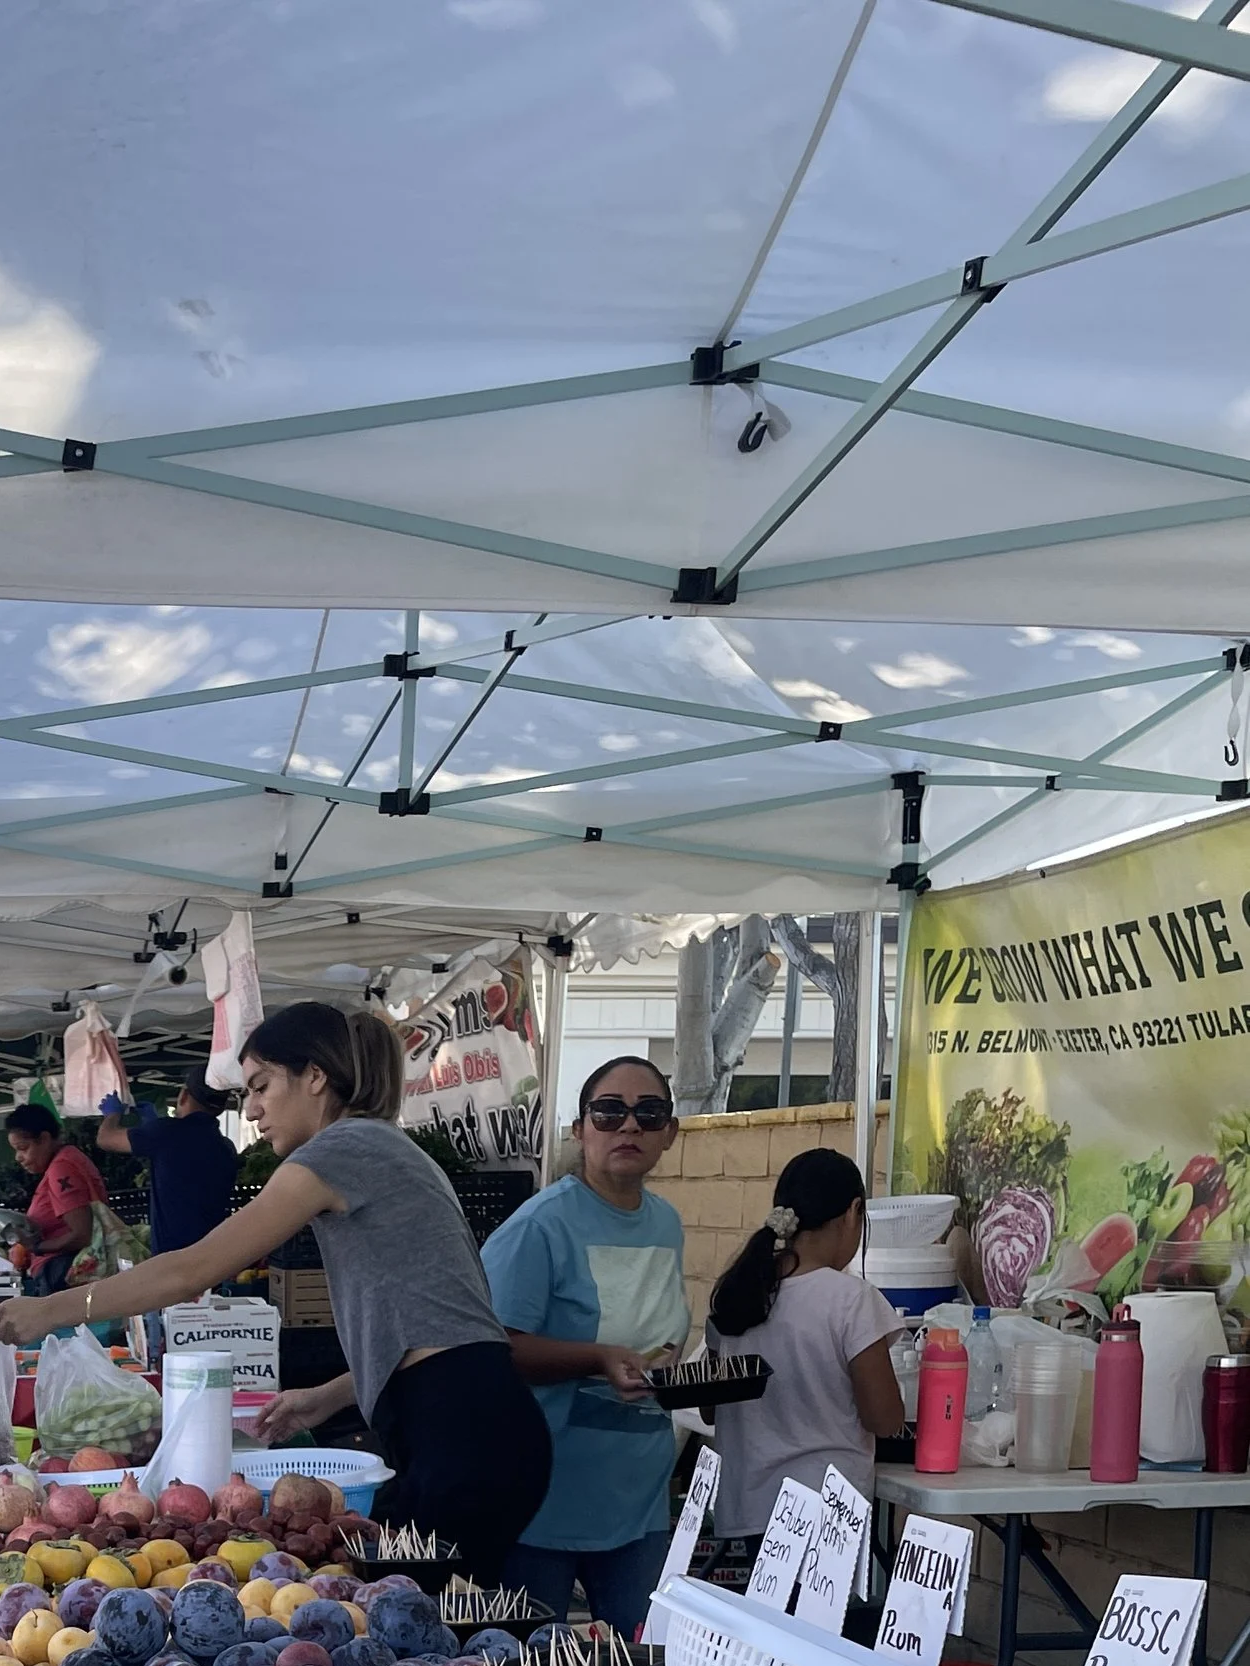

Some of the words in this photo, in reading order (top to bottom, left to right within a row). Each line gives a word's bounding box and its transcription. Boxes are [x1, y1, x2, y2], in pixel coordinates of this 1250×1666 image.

[923, 948, 982, 1004] WE
[979, 942, 1048, 1004] GROW
[1041, 920, 1152, 1001] WHAT
[1148, 899, 1244, 982] WE
[951, 1030, 969, 1054] N.
[977, 1028, 1053, 1054] BELMONT
[1056, 1026, 1110, 1056] EXETER,
[1108, 1023, 1133, 1050] CA
[1132, 1015, 1187, 1048] 93221
[433, 1057, 462, 1093] Luis
[174, 1327, 275, 1346] CALIFORNIE
[763, 1526, 791, 1563] Gem
[751, 1557, 778, 1597] Plum
[806, 1548, 835, 1607] Plum
[1099, 1596, 1180, 1655] BOSSC
